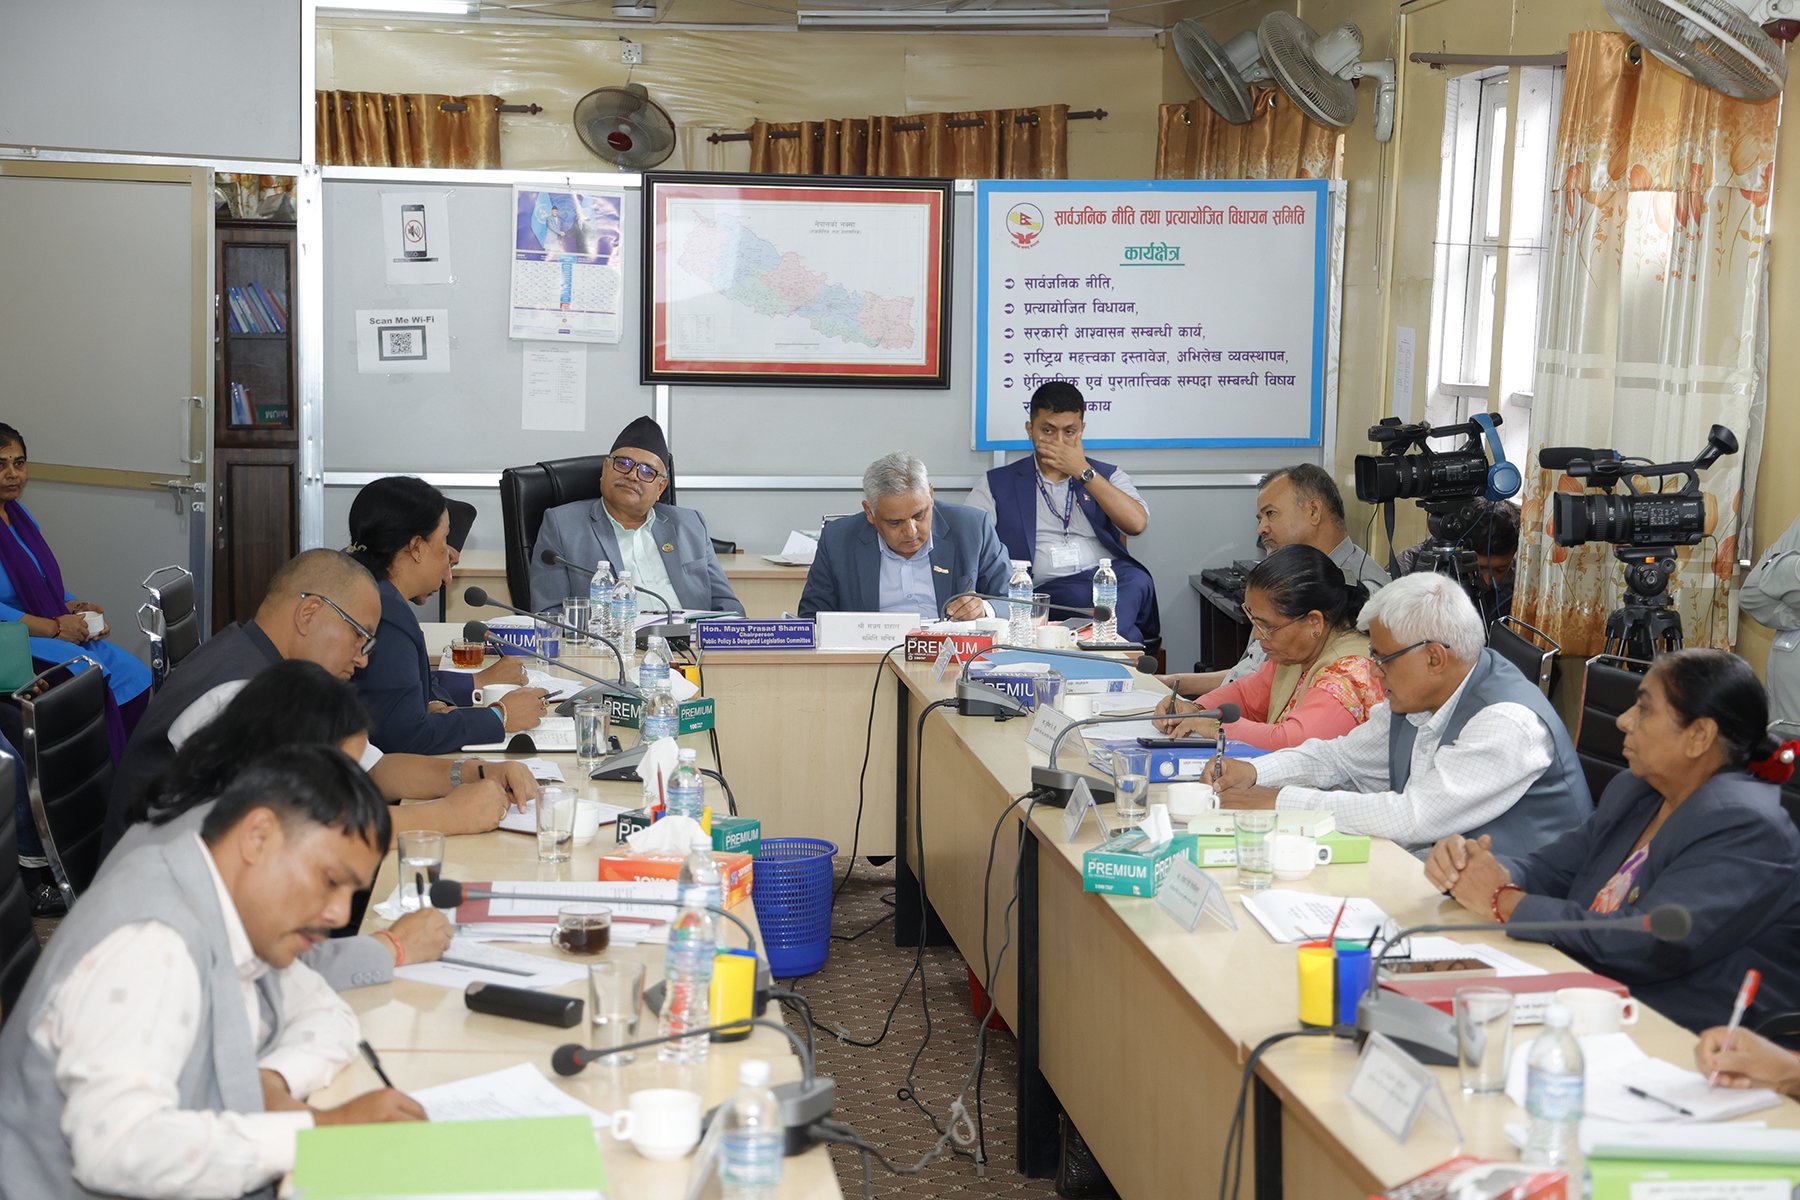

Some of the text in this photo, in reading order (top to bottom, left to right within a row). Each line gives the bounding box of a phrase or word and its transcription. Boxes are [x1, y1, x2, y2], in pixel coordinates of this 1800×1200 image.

[1054, 205, 1306, 227] सार्वजनिक नीति तथा प्रत्यायोजित विधायन समिति
[1124, 241, 1181, 262] कार्यक्षेत्र
[1024, 273, 1115, 291] सार्वजनिक नीति,
[1024, 298, 1139, 316] प्रत्यायोजित विधायन,
[369, 315, 435, 325] Scan Me Wi-Fi
[1023, 322, 1206, 340] सरकारी आश्वासन सम्बन्धी कार्य,
[1023, 347, 1289, 367] राष्ट्रिय महत्त्वका दस्तावेज, अभिलेख व्यवस्थापन,
[1085, 373, 1103, 390] एवं
[1108, 372, 1172, 391] पुरातात्त्विक
[1177, 375, 1212, 388] सम्पदा
[1217, 371, 1259, 388] सम्बन्धी
[1264, 371, 1296, 386] विषय
[724, 625, 745, 634] Maya
[778, 624, 810, 632] Sharma
[717, 638, 732, 646] Policy
[907, 640, 978, 655] PREUM
[681, 704, 713, 719] PREMIUM
[725, 828, 759, 848] PREMIUM
[1088, 861, 1148, 879] PREMIUM
